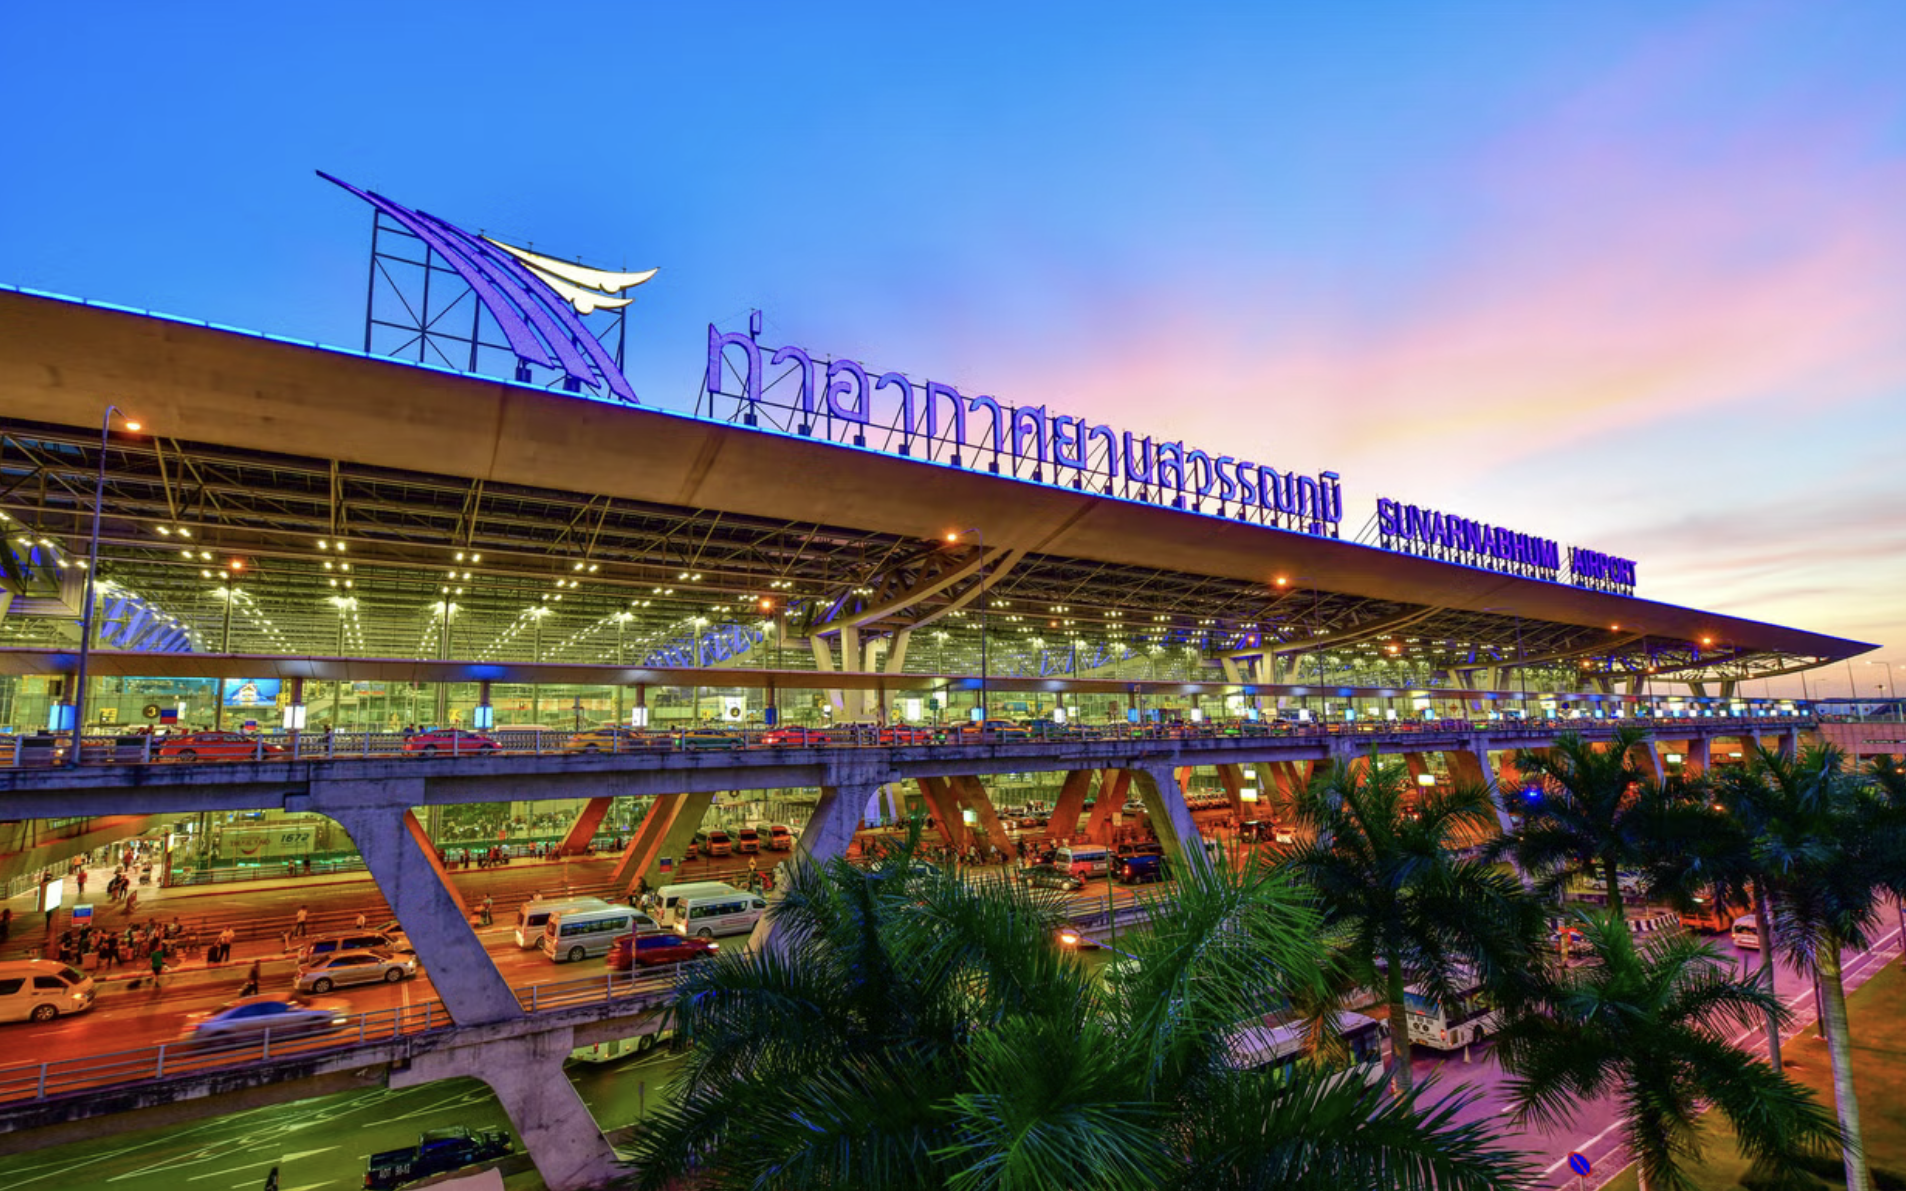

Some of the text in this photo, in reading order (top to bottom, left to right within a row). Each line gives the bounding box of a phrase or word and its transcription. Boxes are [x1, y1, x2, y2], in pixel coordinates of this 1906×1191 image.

[707, 310, 1342, 535] ท่าอากาศยานสุวรรณภูมิ
[1378, 496, 1637, 587] SUVARNABHUMI AIRPORT
[281, 832, 310, 843] 1672
